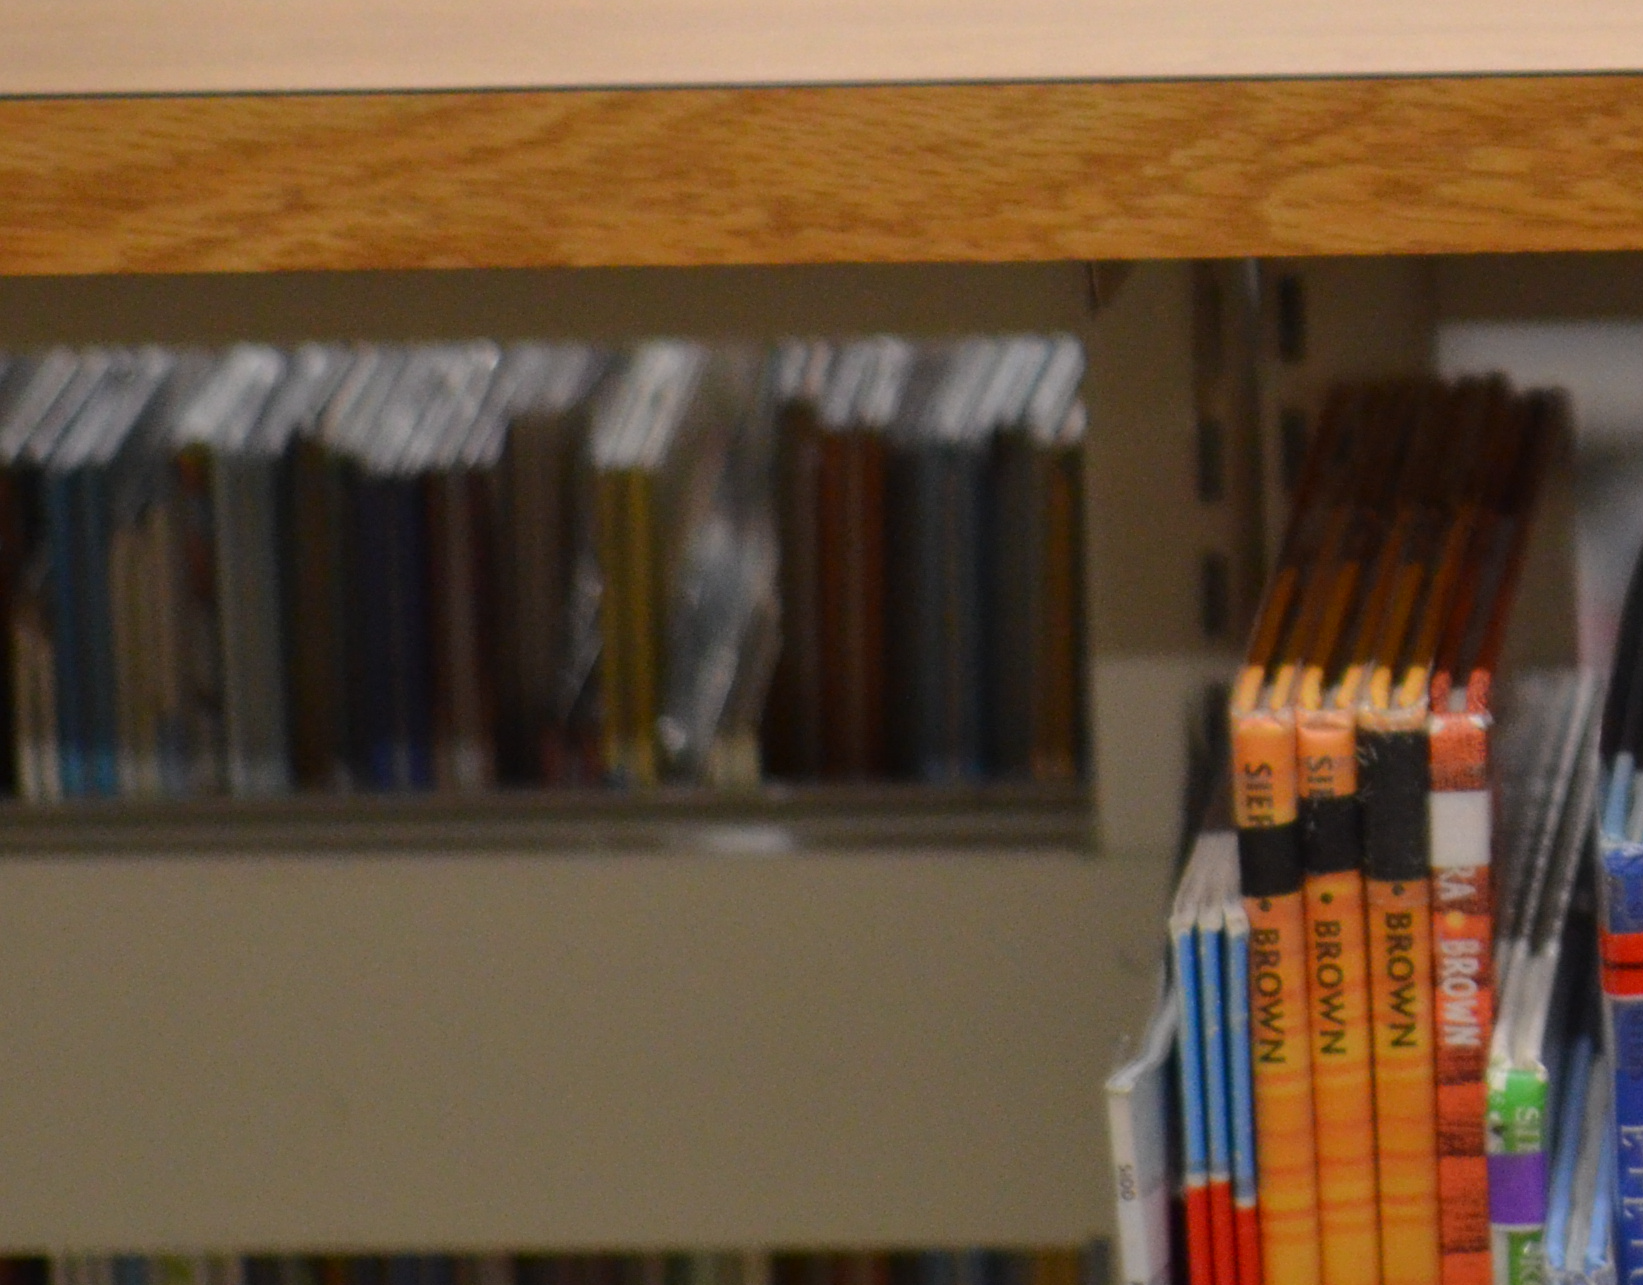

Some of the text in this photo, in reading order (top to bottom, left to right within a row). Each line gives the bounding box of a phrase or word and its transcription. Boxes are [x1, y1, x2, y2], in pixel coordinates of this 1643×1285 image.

[1252, 928, 1285, 1064] BROWN
[1315, 920, 1347, 1056] BROWN
[1385, 912, 1418, 1048] BROWN
[1440, 938, 1481, 1047] BROWN
